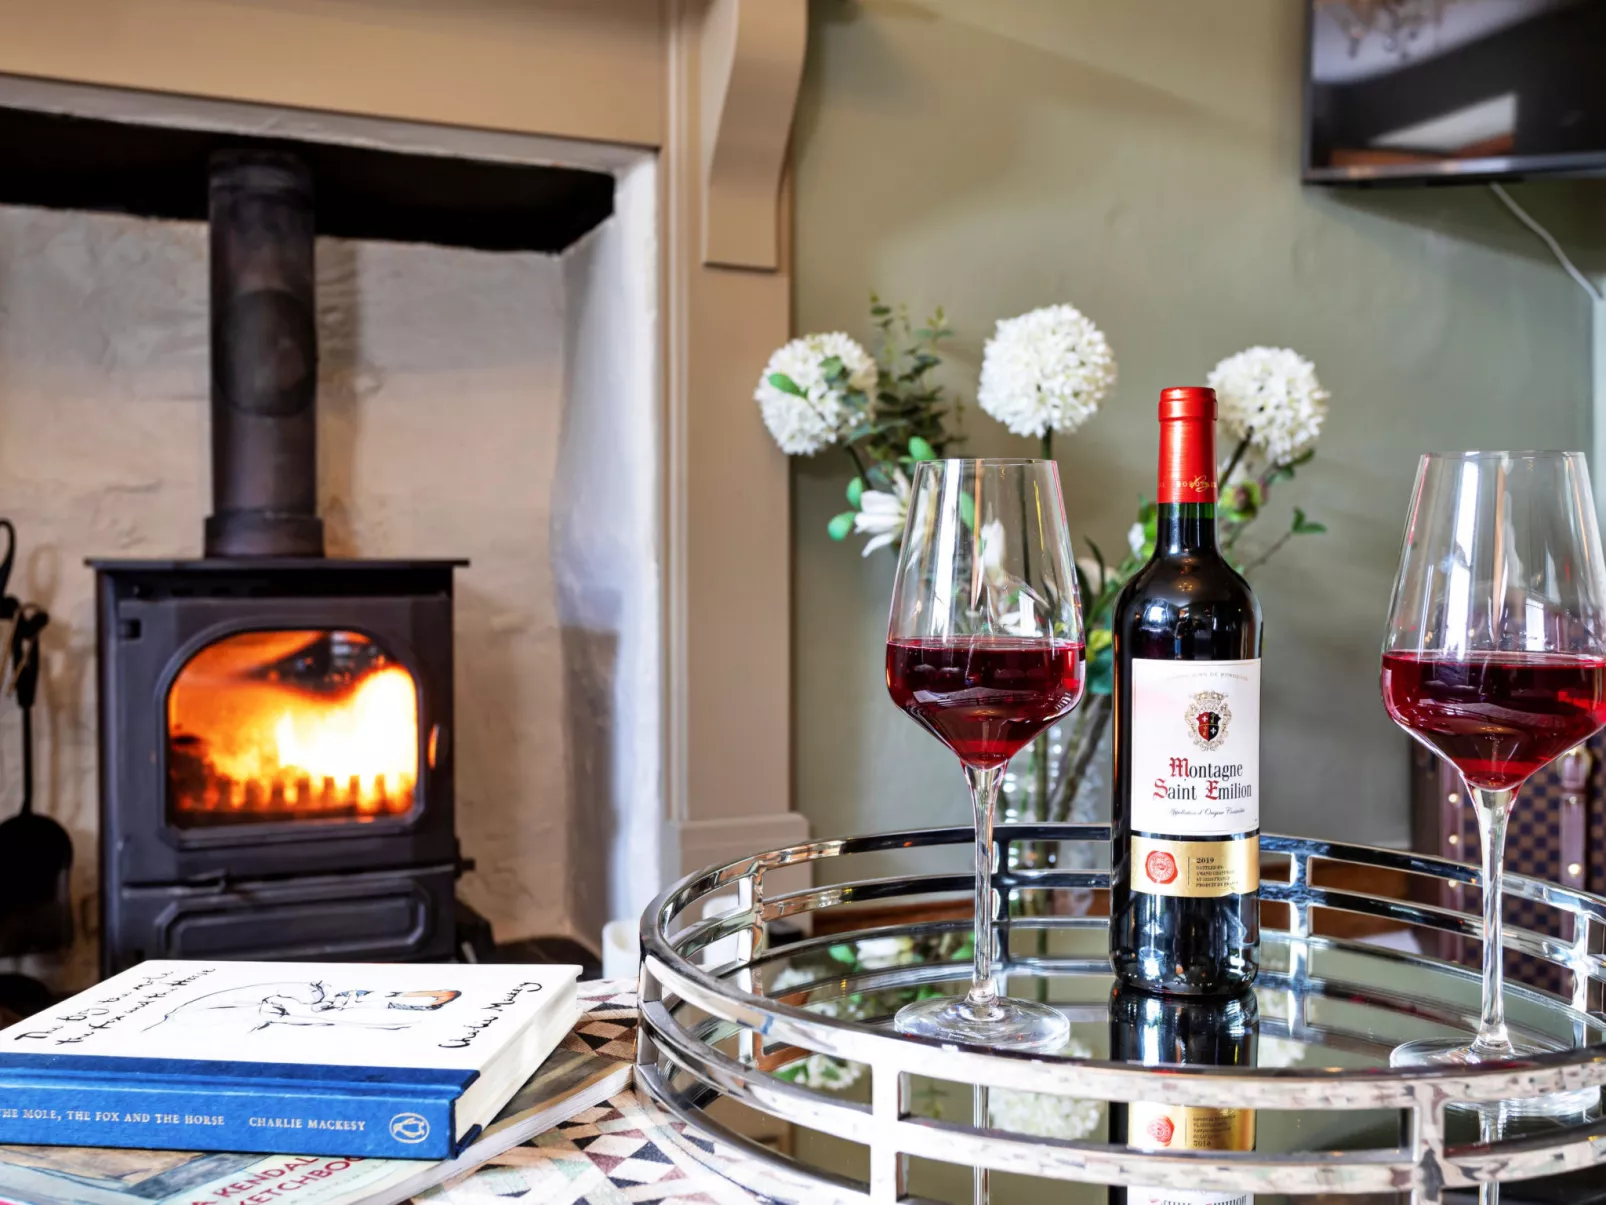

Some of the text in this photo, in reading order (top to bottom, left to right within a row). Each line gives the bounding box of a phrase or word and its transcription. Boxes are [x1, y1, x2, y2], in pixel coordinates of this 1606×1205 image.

[1169, 757, 1243, 780] Montagne
[1153, 778, 1252, 801] Saint Emilion
[23, 1109, 62, 1122] MOLE,
[66, 1110, 90, 1121] THE
[95, 1111, 120, 1122] FOX
[124, 1113, 150, 1123] AND
[155, 1113, 179, 1124] THE
[184, 1115, 225, 1126] HORSE
[248, 1116, 366, 1131] CHARLIE MACKESY
[213, 1157, 320, 1198] KENDAL
